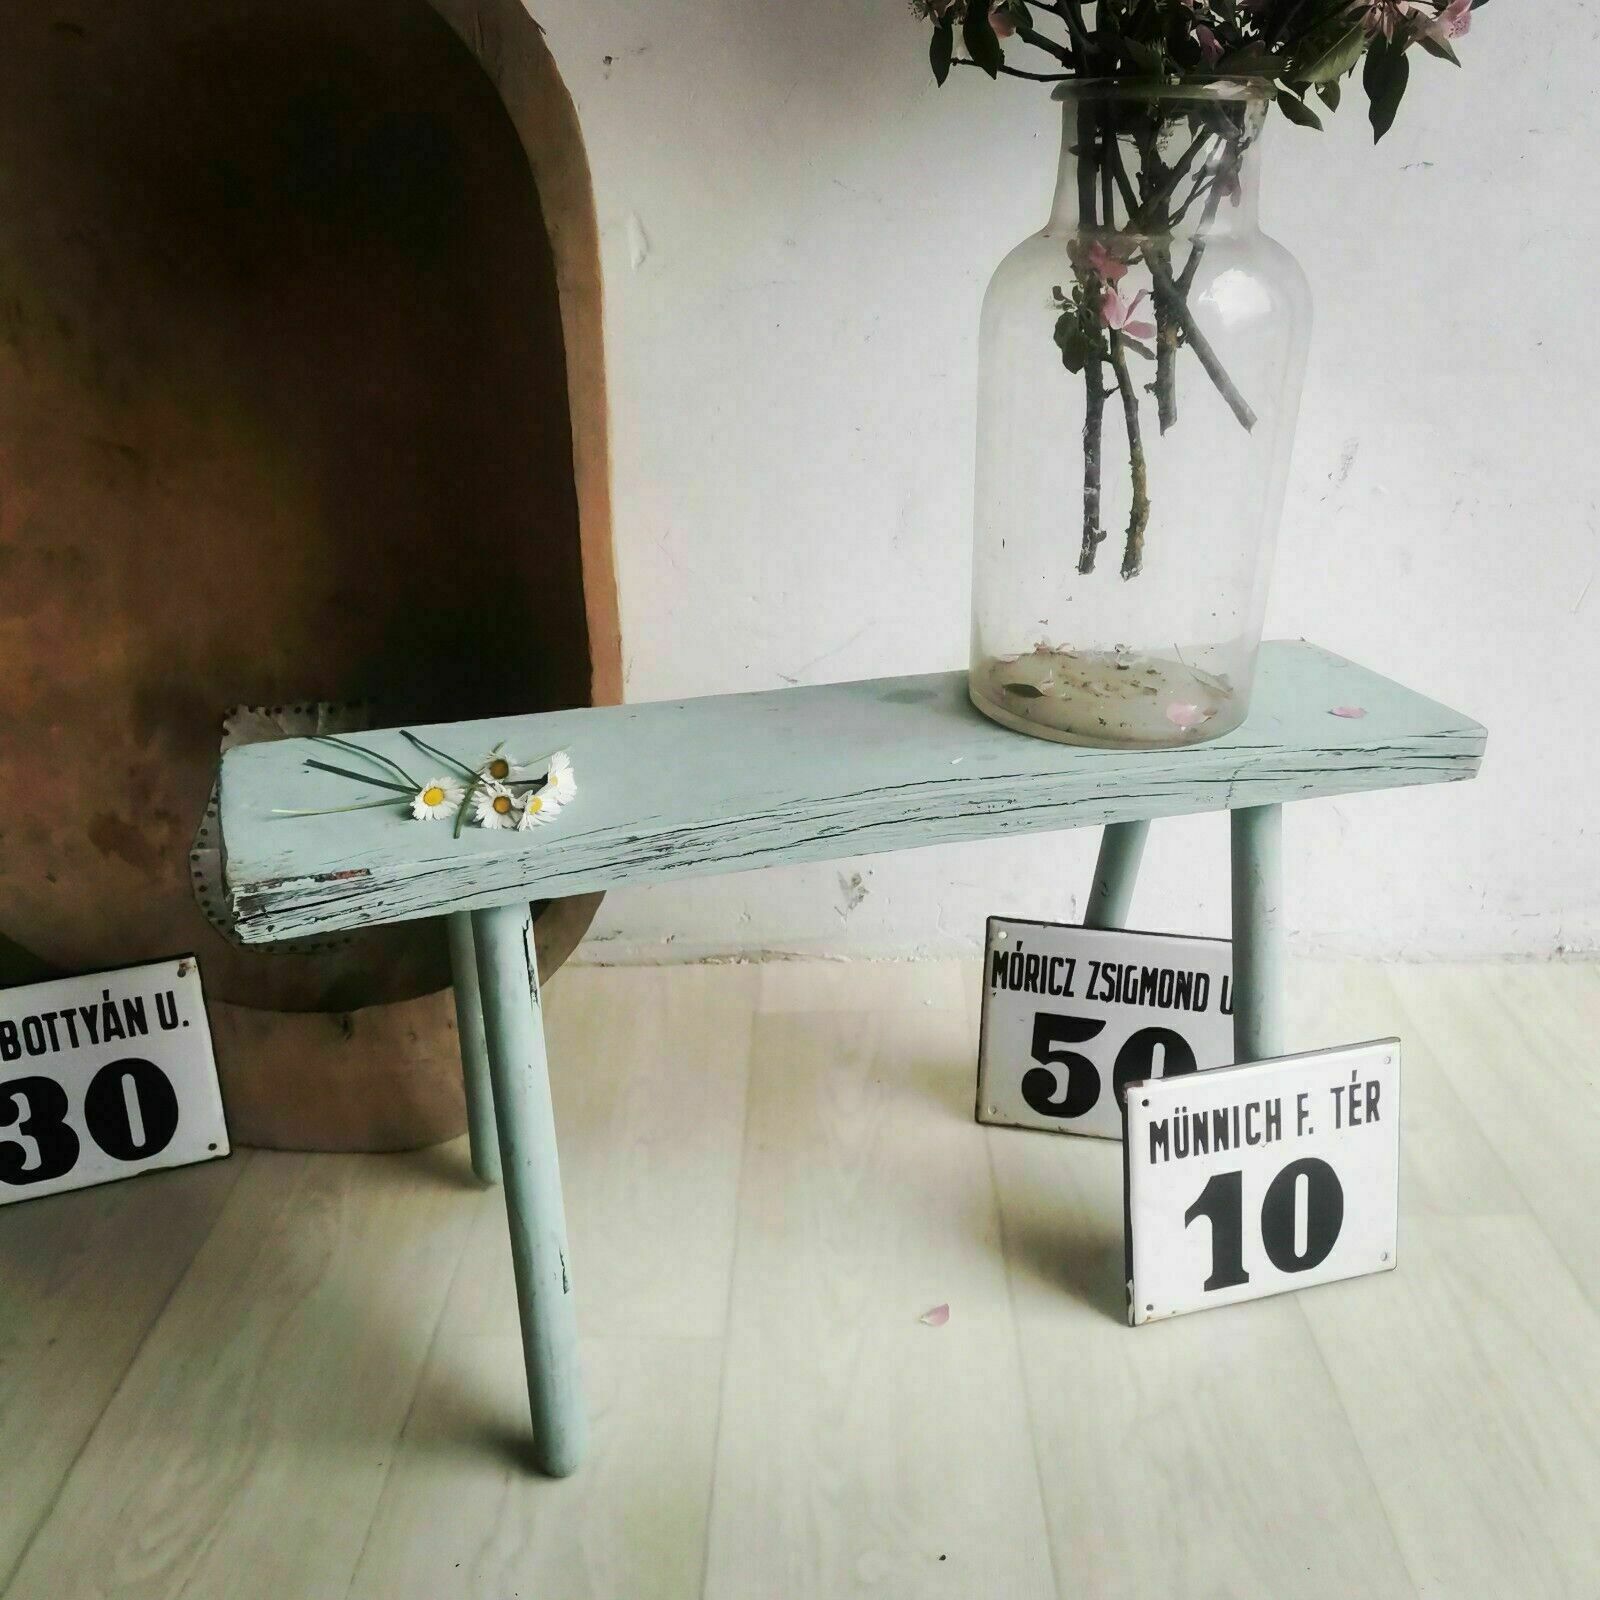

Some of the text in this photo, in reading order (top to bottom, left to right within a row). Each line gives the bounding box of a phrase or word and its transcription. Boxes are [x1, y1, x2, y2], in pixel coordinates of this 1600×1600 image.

[991, 941, 1077, 998] MÓRICZ
[1085, 960, 1210, 1012] ZSIGMOND
[0, 989, 189, 1062] BOTTYÁN U.
[0, 1057, 179, 1186] 30
[1149, 1069, 1381, 1165] MÜNNICH F. TÉR
[1184, 1156, 1344, 1292] 10
